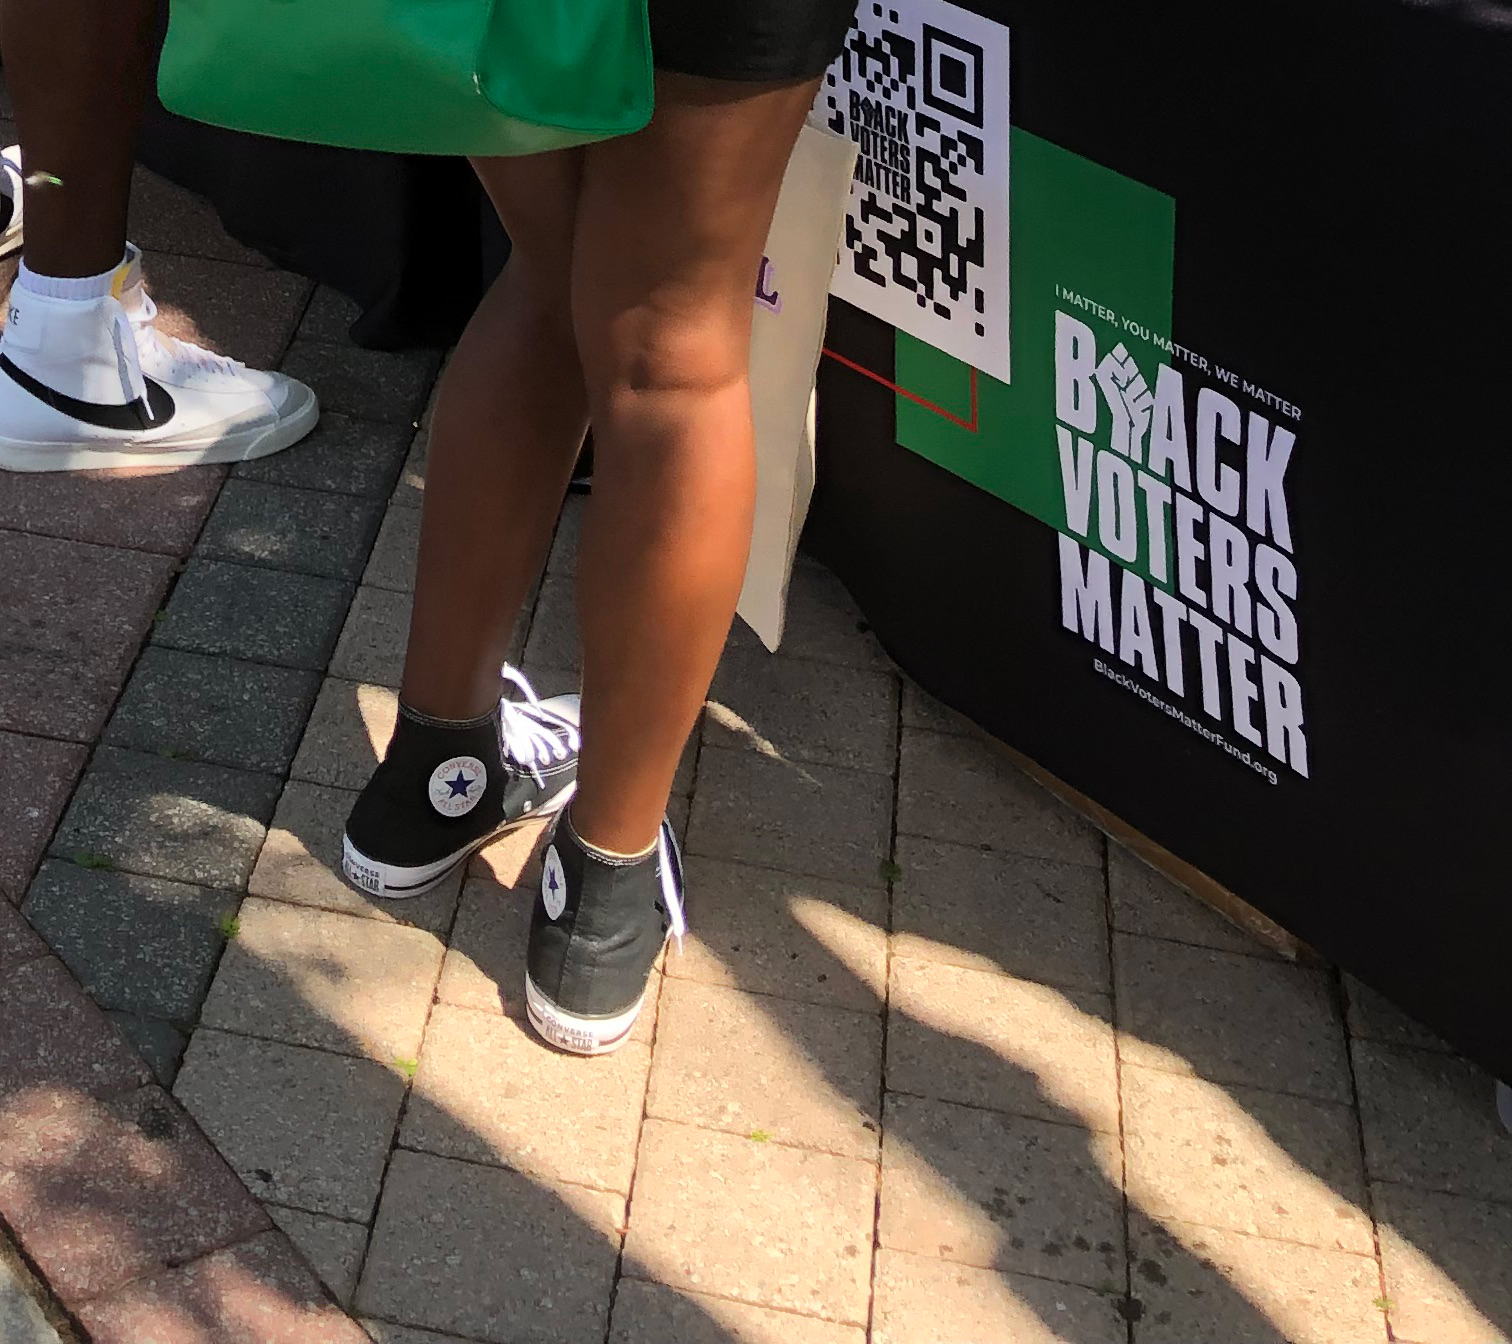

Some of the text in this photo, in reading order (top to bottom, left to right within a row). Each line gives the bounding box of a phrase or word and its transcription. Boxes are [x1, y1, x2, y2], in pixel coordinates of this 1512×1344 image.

[849, 120, 911, 175] VOTERS
[853, 153, 911, 204] MATTER
[1055, 283, 1303, 421] I MATTER, YOU MATTER, WE MATTER
[1055, 423, 1300, 666] VOTERS
[1057, 531, 1310, 780] MATTER
[1093, 657, 1278, 786] BlackVotersMatterFund.org
[545, 1015, 594, 1038] CONVERSE
[571, 1036, 593, 1052] STAR
